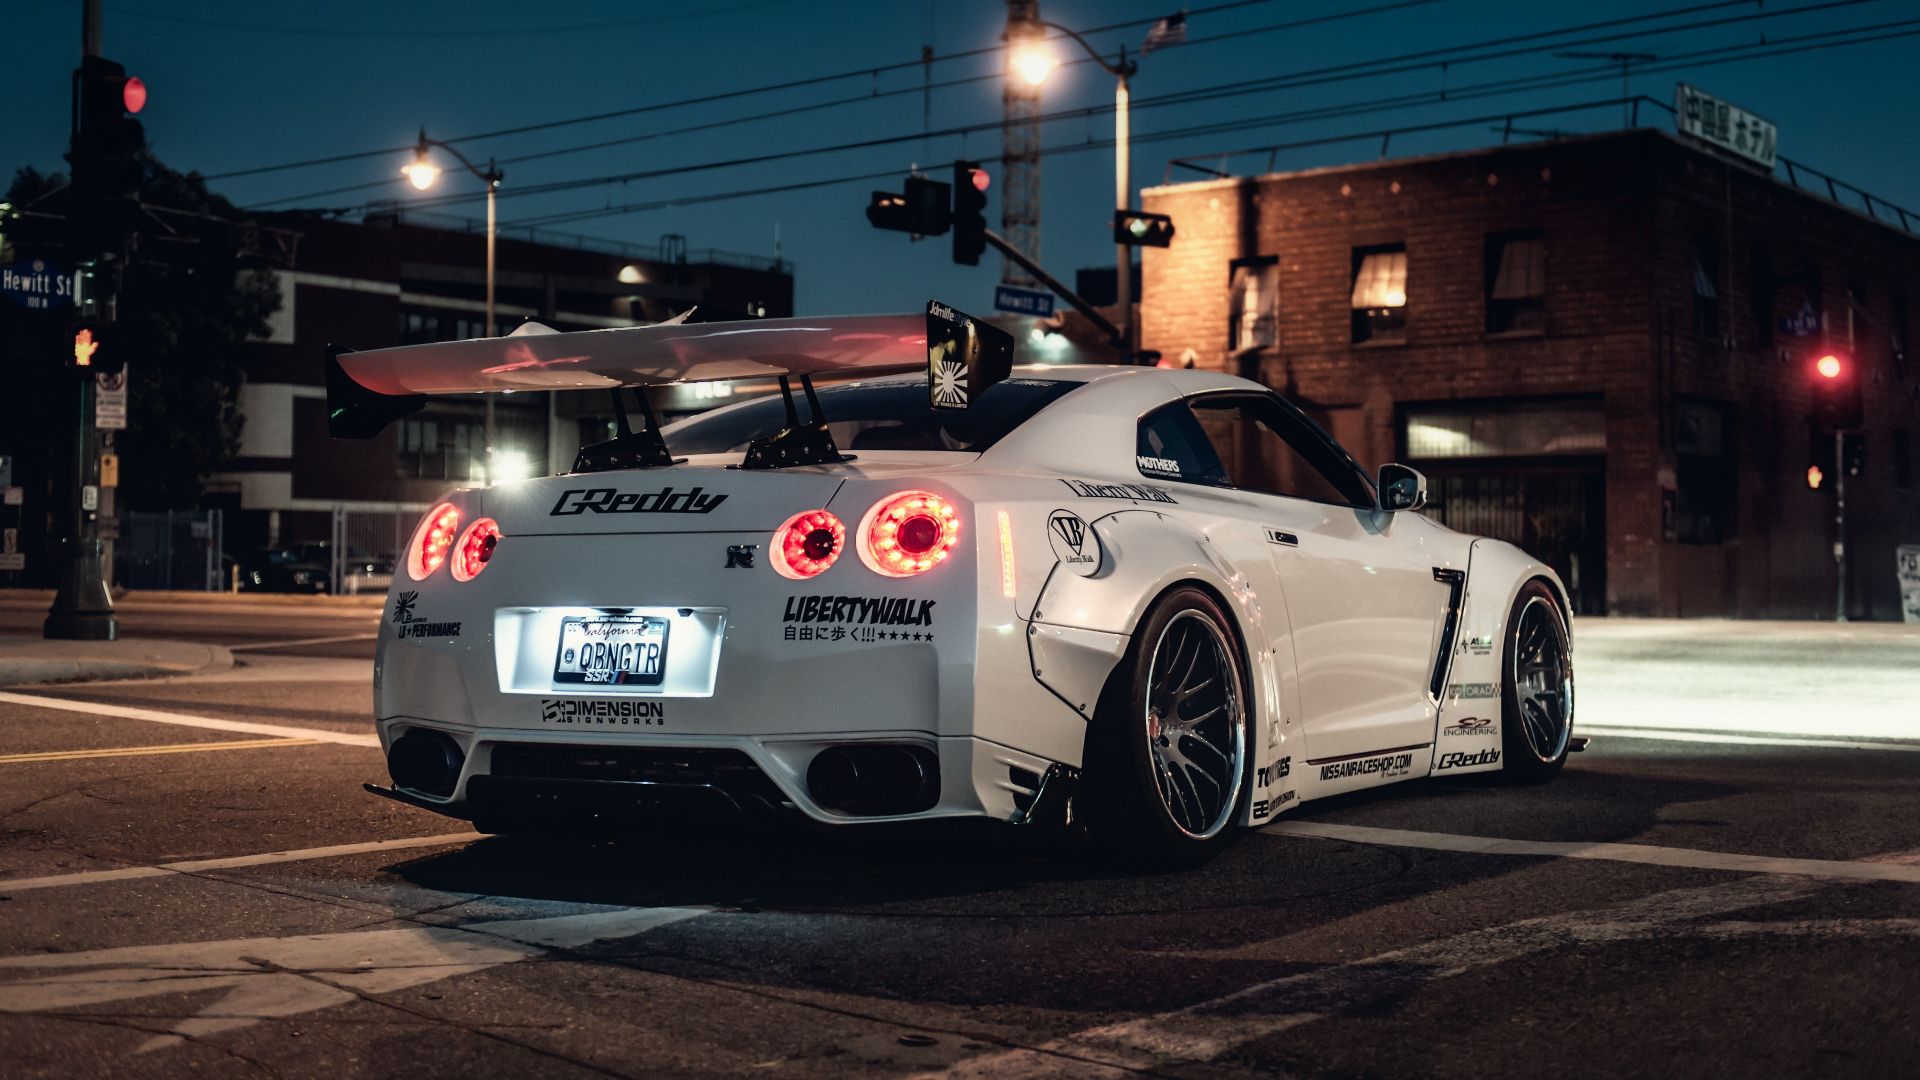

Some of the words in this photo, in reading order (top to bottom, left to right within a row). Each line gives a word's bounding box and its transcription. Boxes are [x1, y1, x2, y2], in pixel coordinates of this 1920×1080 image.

[3, 269, 50, 294] Hewitt
[56, 274, 72, 296] St
[1136, 455, 1180, 473] MOTHERS
[549, 487, 730, 516] GReddy
[1057, 478, 1139, 506] Liberty
[1119, 483, 1180, 505] Walk
[782, 595, 937, 627] LIBERTYWALK
[583, 621, 646, 641] California
[579, 642, 659, 673] QBNGTR
[584, 669, 610, 682] SSR
[566, 716, 664, 726] SIGNWORKS
[1443, 727, 1498, 737] ENGINEERING
[1319, 754, 1413, 782] NISSANRACESHOP.COM
[1438, 748, 1501, 770] GReddy
